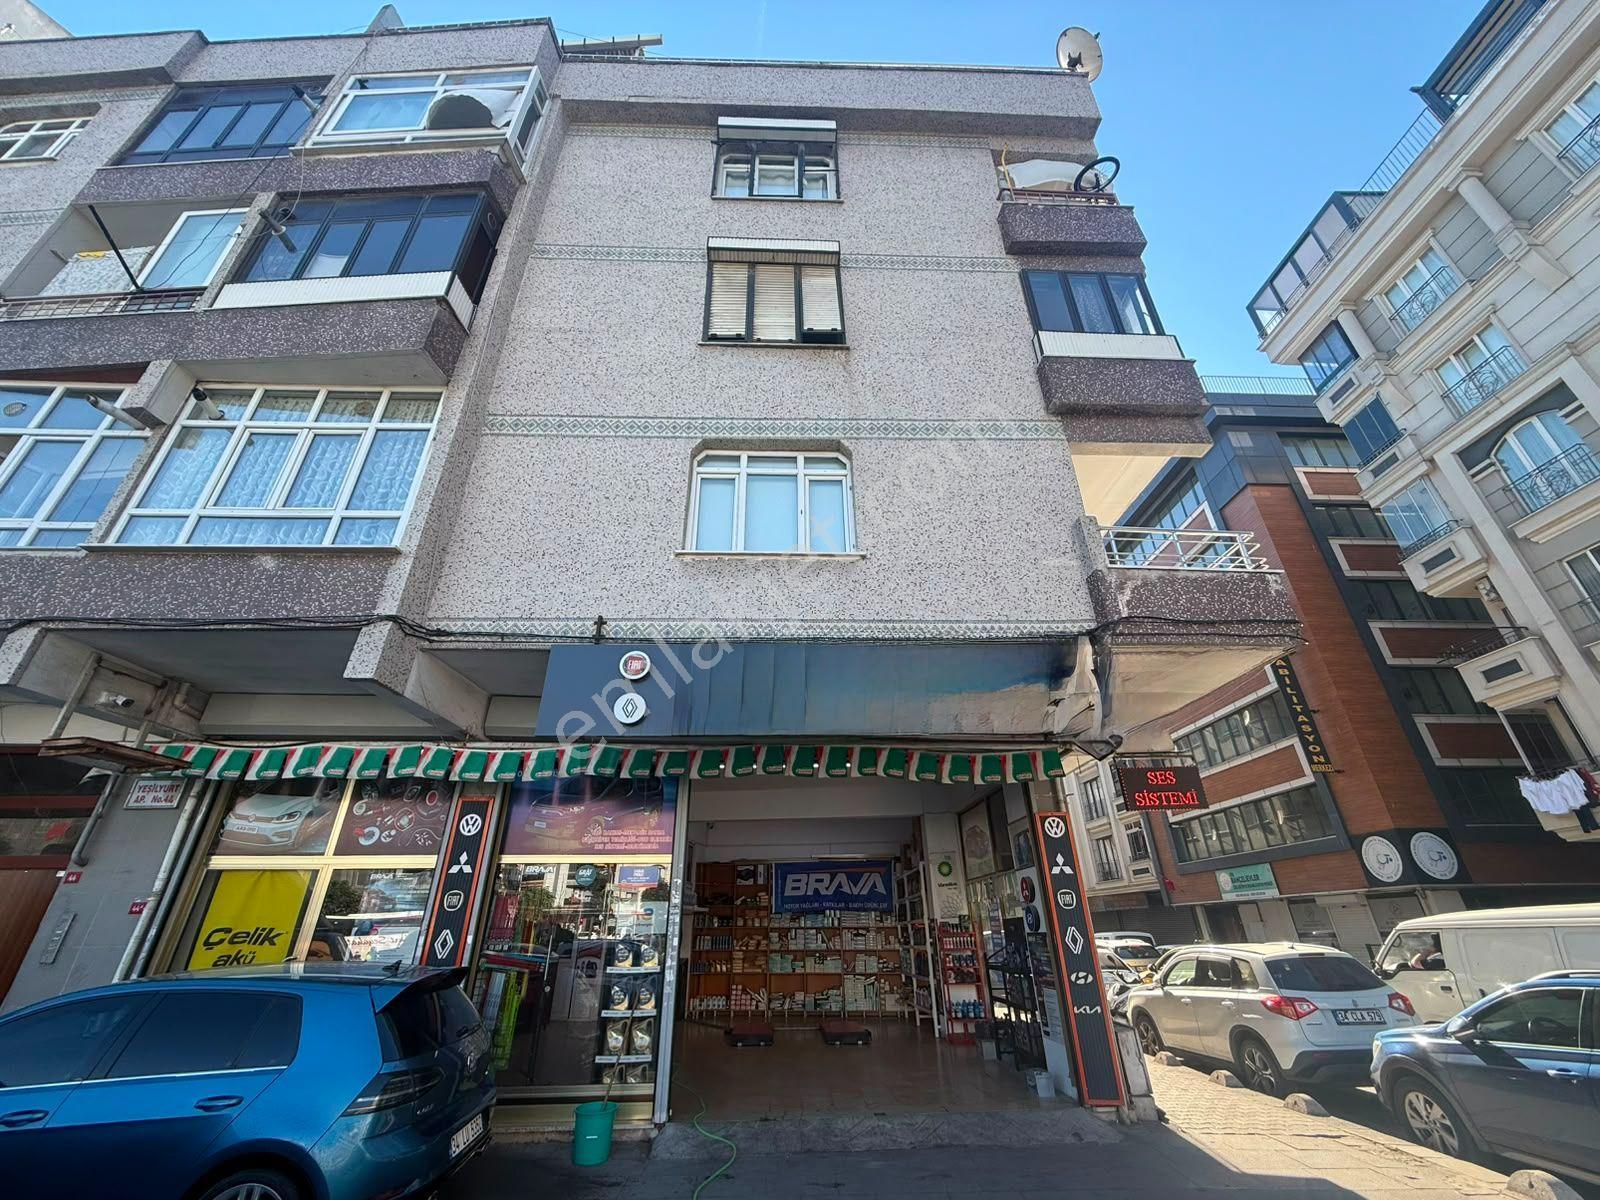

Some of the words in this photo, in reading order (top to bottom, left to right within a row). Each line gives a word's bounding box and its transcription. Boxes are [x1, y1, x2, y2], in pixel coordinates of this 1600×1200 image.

[1147, 771, 1176, 784] SES
[1135, 788, 1200, 806] SİSTEMİ
[784, 873, 887, 896] BRAVA
[203, 927, 285, 950] Çelik
[212, 949, 256, 967] akü
[1338, 1012, 1349, 1021] 34
